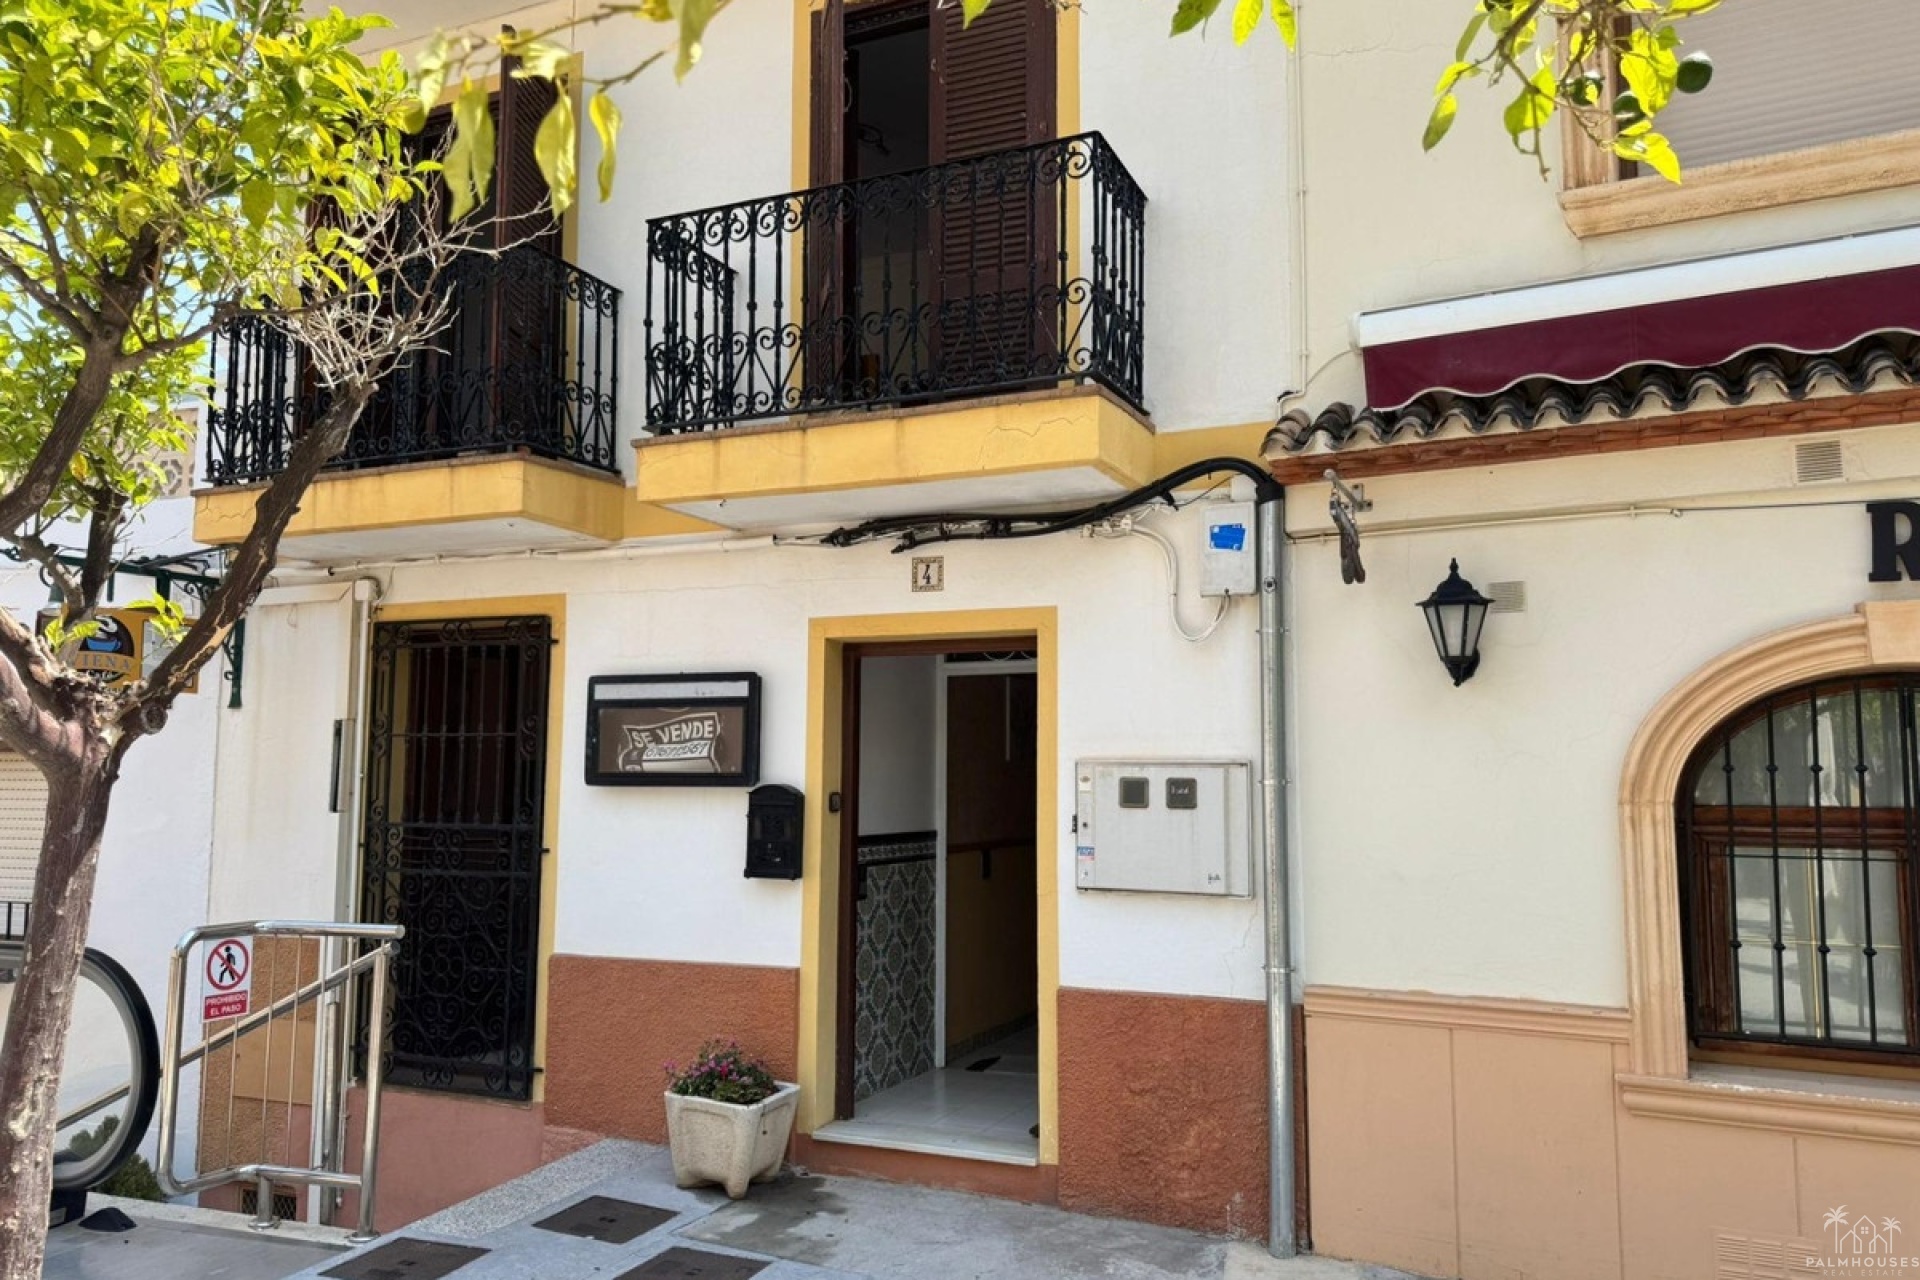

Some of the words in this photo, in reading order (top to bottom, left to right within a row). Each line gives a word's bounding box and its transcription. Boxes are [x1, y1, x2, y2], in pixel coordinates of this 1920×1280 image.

[1866, 502, 1920, 582] R
[922, 564, 932, 585] 4
[631, 730, 656, 748] SE
[656, 720, 714, 744] VENDE
[206, 993, 247, 1005] PROHIBIDO
[210, 1006, 220, 1016] EL
[220, 1003, 243, 1014] PASO
